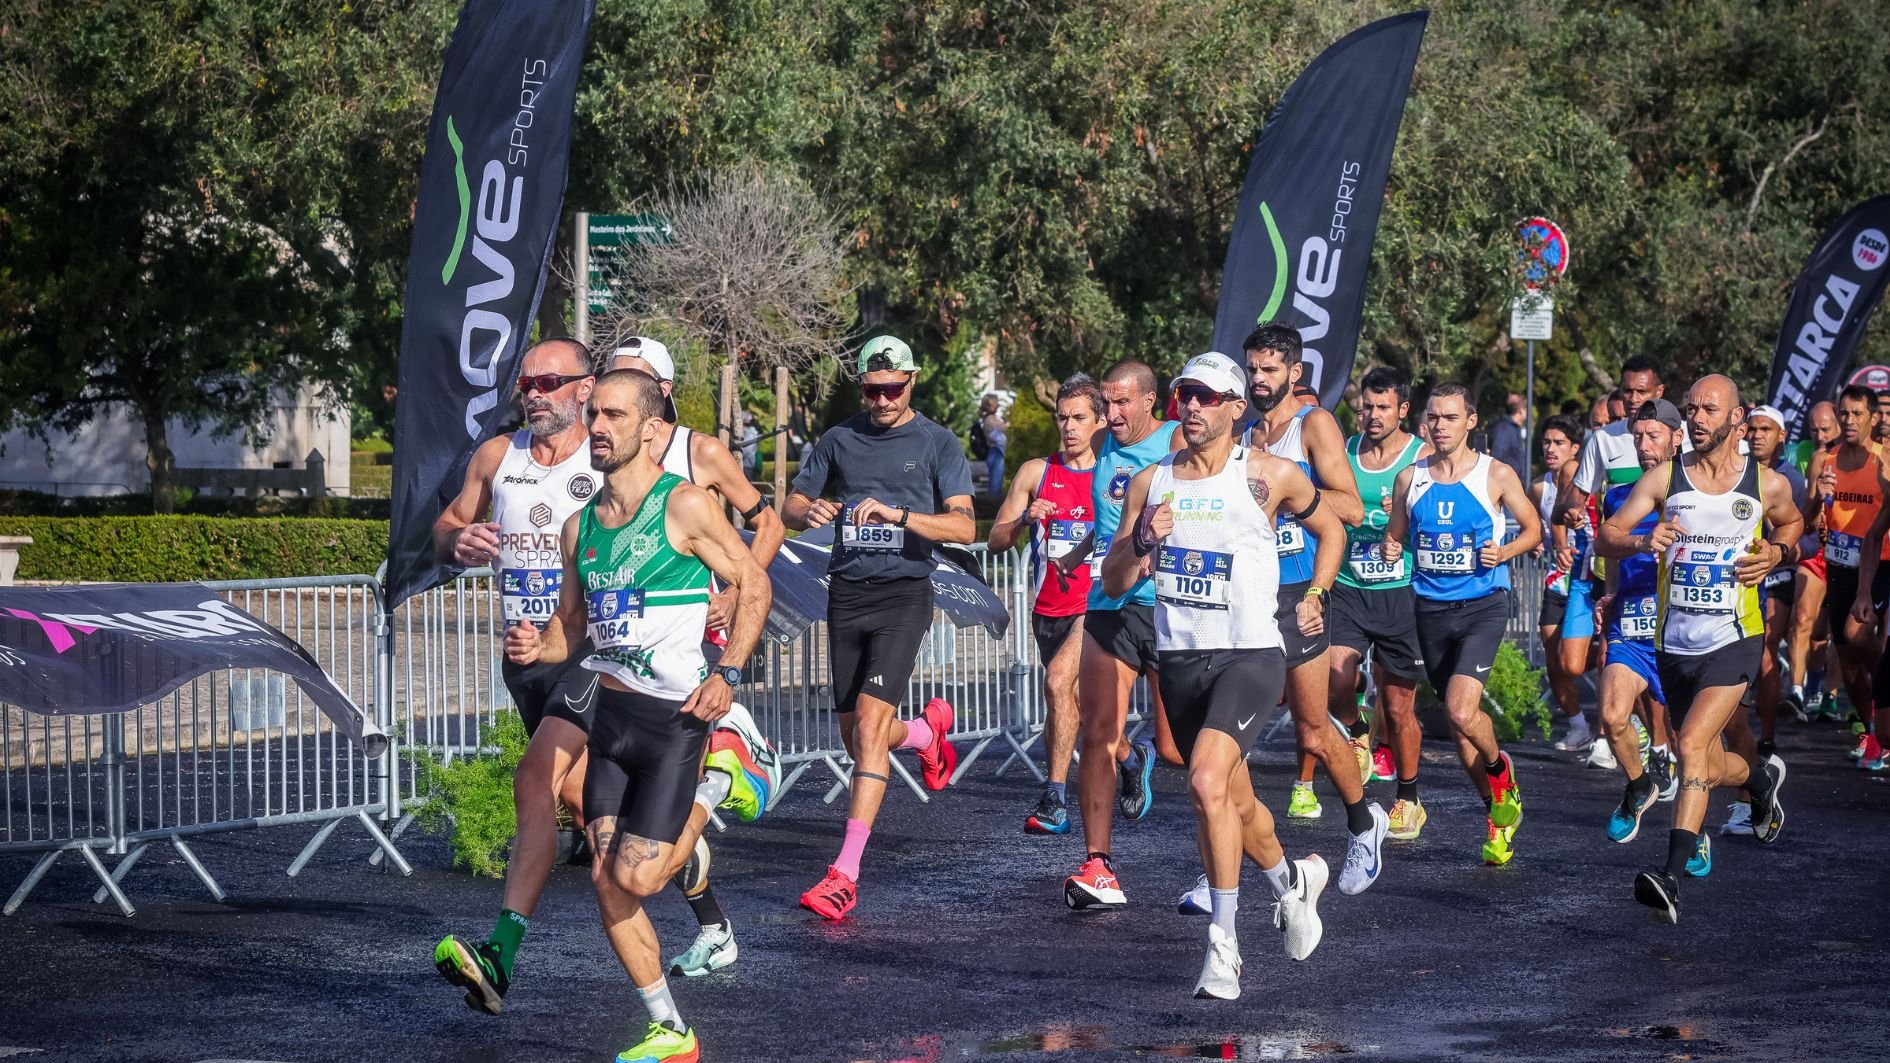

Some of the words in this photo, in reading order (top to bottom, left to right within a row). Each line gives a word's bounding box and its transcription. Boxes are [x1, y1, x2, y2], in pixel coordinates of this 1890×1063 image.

[507, 57, 547, 168] SPORTS
[1329, 160, 1361, 243] SPORTS
[571, 486, 591, 494] TEJO
[1179, 499, 1225, 510] GFD
[1173, 511, 1224, 521] RUNNING
[855, 527, 893, 542] 1859
[1430, 553, 1465, 565] 1292
[1206, 573, 1226, 581] 10KM
[1176, 577, 1212, 597] 1101
[1683, 588, 1723, 603] 1353
[520, 599, 558, 615] 2011
[596, 620, 630, 642] 1064
